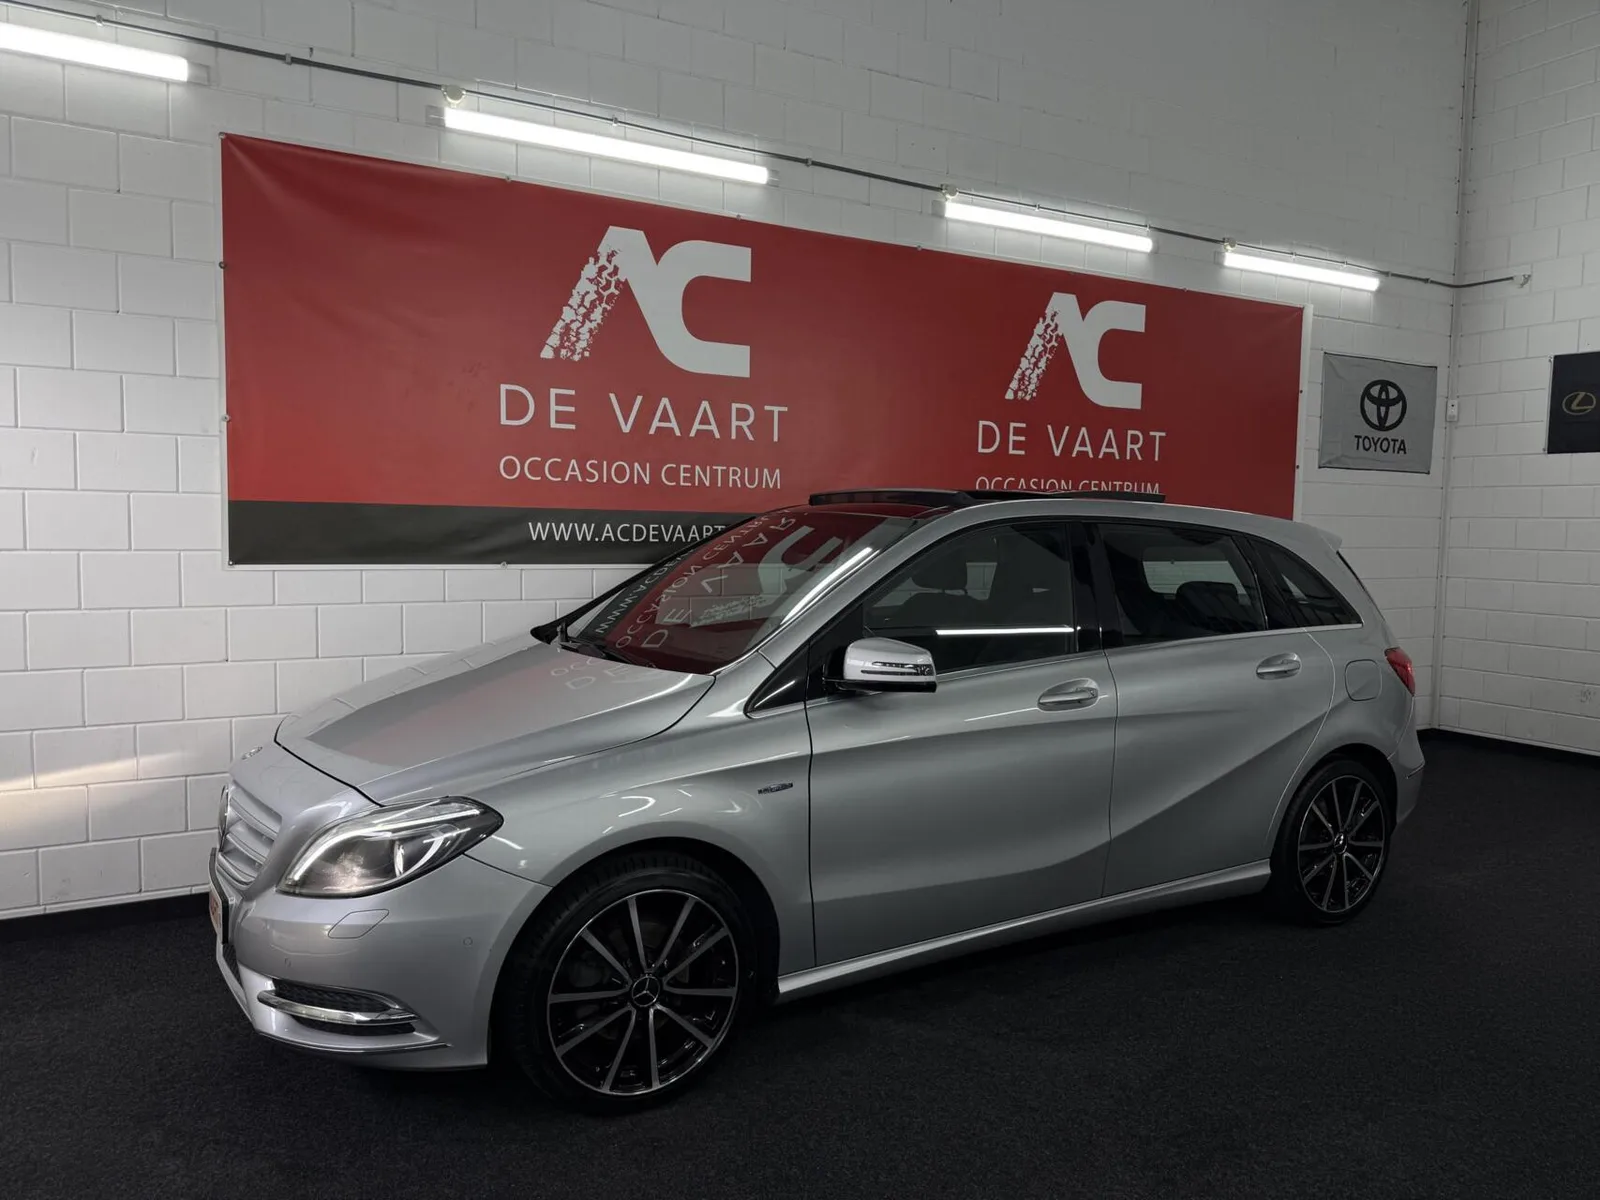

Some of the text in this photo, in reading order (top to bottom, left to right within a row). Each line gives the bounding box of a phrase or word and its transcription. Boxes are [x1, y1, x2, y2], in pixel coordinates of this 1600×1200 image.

[539, 225, 752, 378] AC
[1004, 291, 1146, 410] AC
[499, 383, 789, 443] DE VAART
[977, 420, 1167, 462] DE VAART
[1354, 434, 1408, 455] TOYOTA
[499, 454, 782, 490] OCCASION CENTRUM
